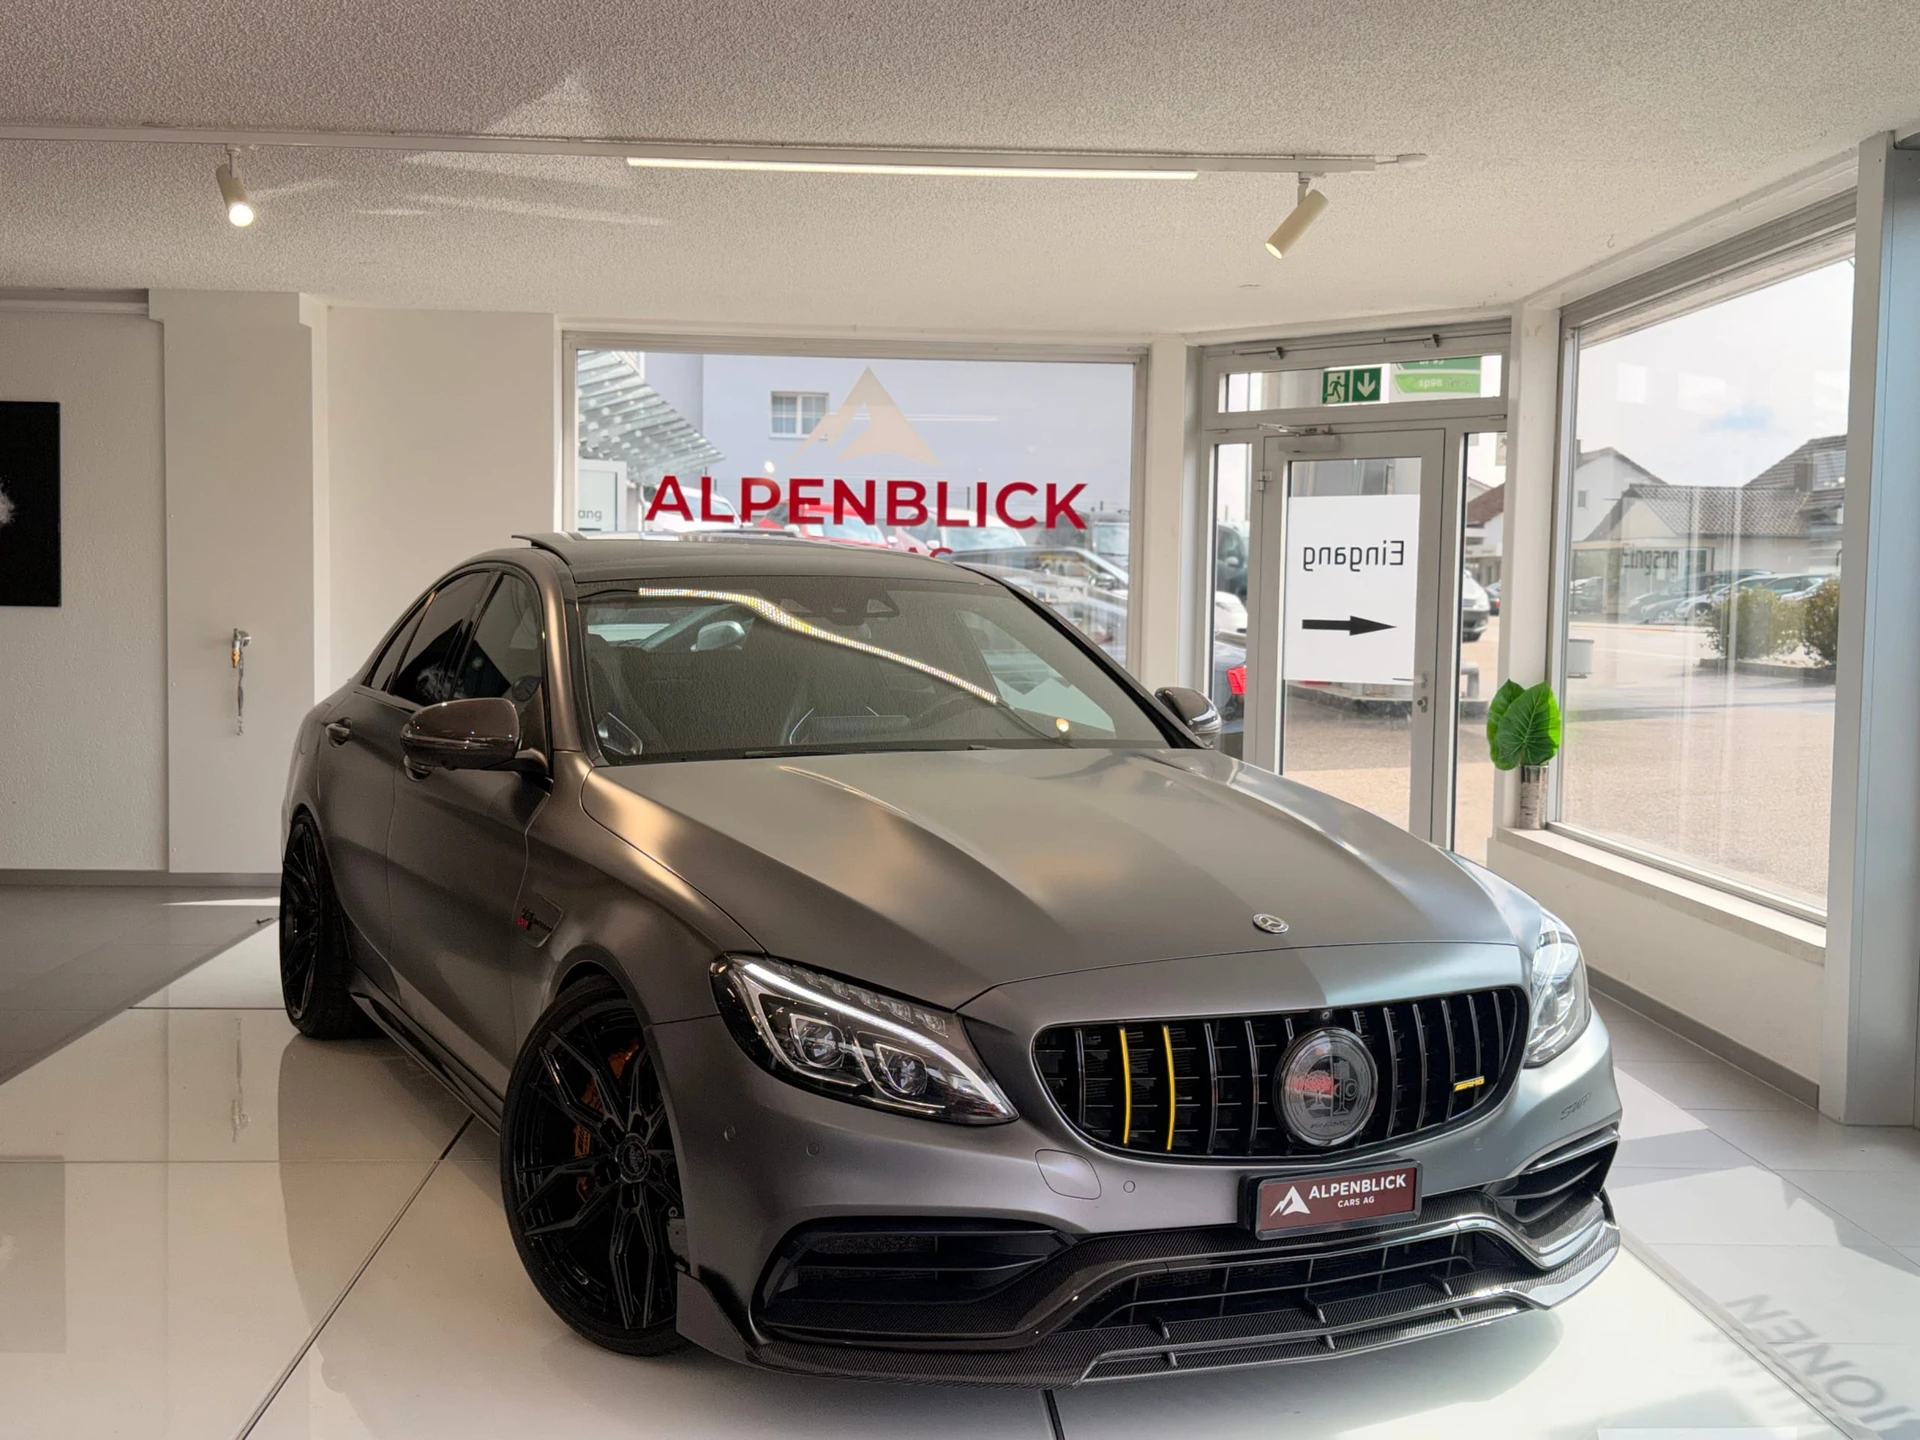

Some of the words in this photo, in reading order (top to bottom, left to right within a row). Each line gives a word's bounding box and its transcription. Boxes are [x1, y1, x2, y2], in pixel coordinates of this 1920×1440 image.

[644, 475, 1089, 530] ALPENBLICK
[1308, 1173, 1407, 1200] ALPENBLICK
[1337, 1198, 1361, 1208] CARS
[1363, 1195, 1375, 1205] AG
